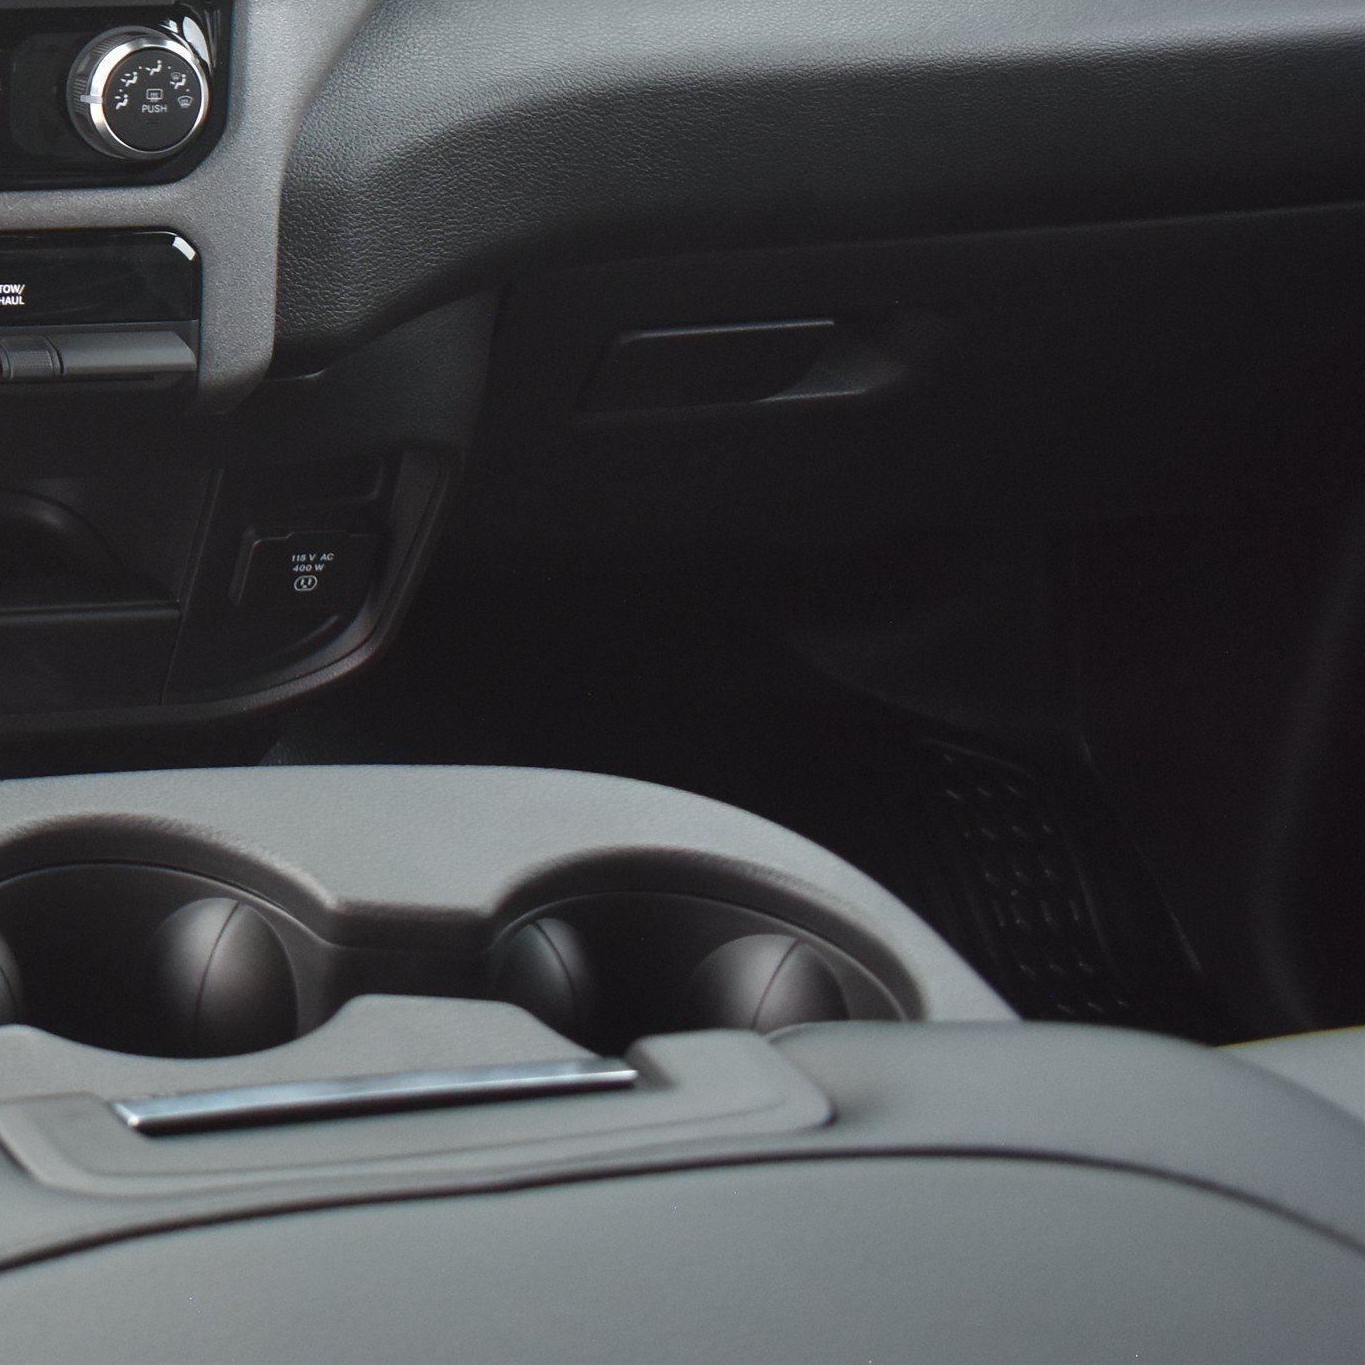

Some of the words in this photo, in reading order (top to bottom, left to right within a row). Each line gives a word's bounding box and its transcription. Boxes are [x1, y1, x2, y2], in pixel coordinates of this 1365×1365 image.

[141, 104, 167, 113] PUSH
[291, 554, 306, 562] 115
[309, 553, 316, 561] V
[319, 552, 334, 561] AC
[292, 564, 312, 572] 400
[315, 563, 324, 571] W
